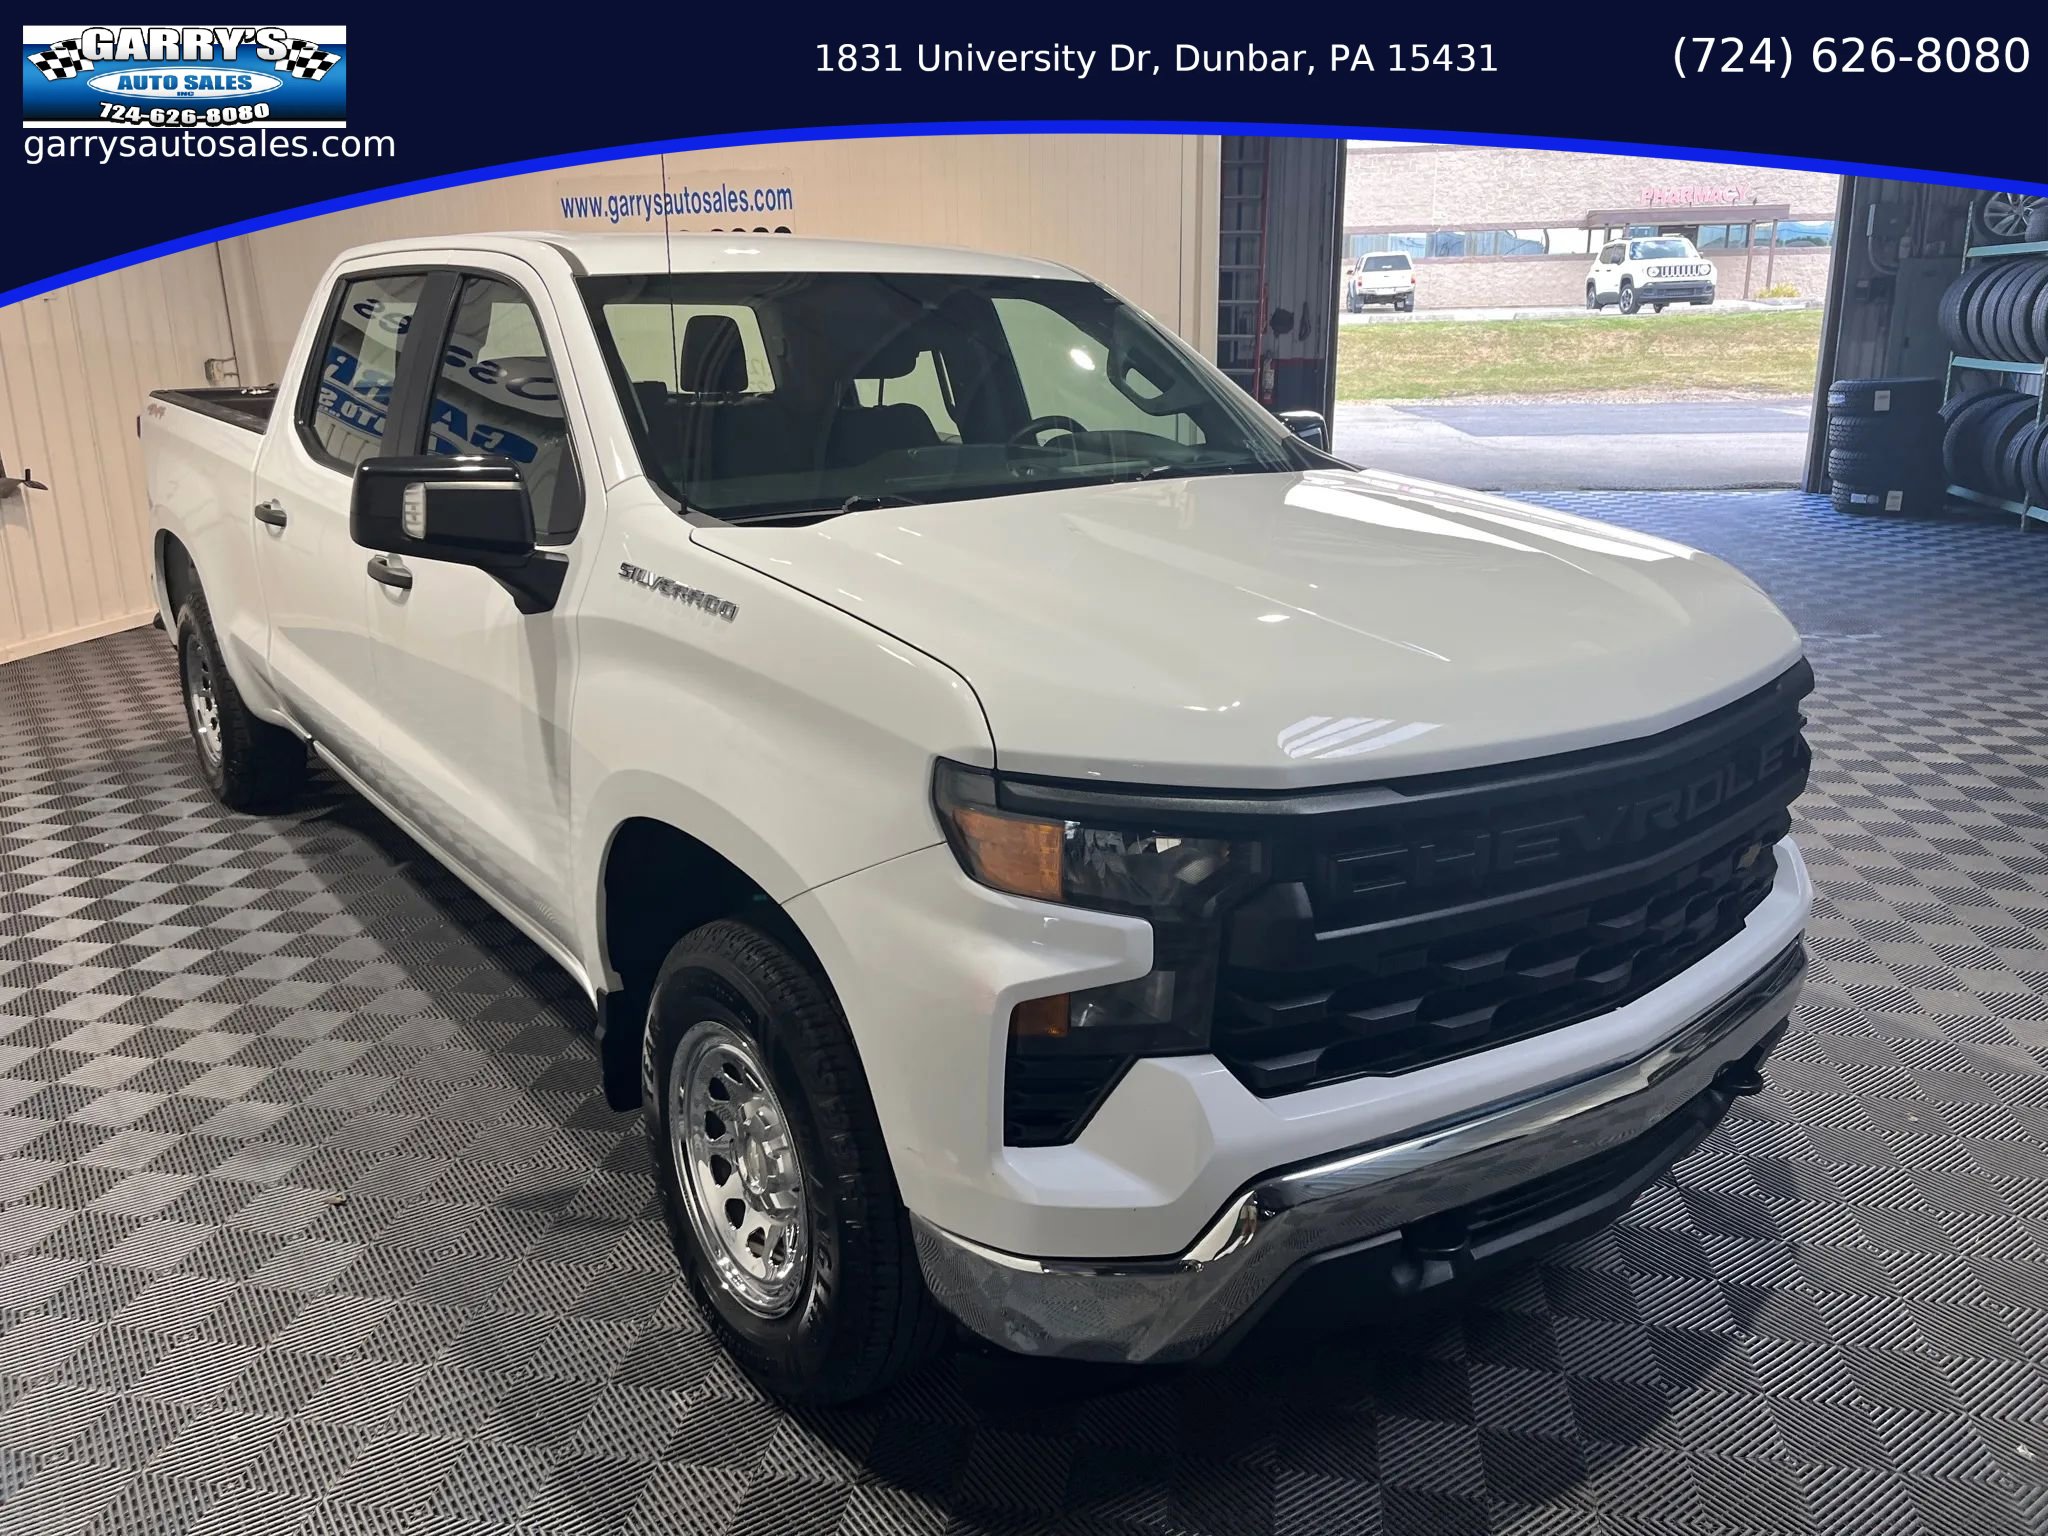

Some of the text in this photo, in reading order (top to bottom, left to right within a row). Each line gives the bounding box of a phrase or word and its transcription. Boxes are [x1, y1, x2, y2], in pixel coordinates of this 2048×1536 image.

[560, 183, 793, 224] www.garrysautosales.com
[1640, 183, 1750, 205] PHARMACY
[618, 562, 740, 623] SILVERADO
